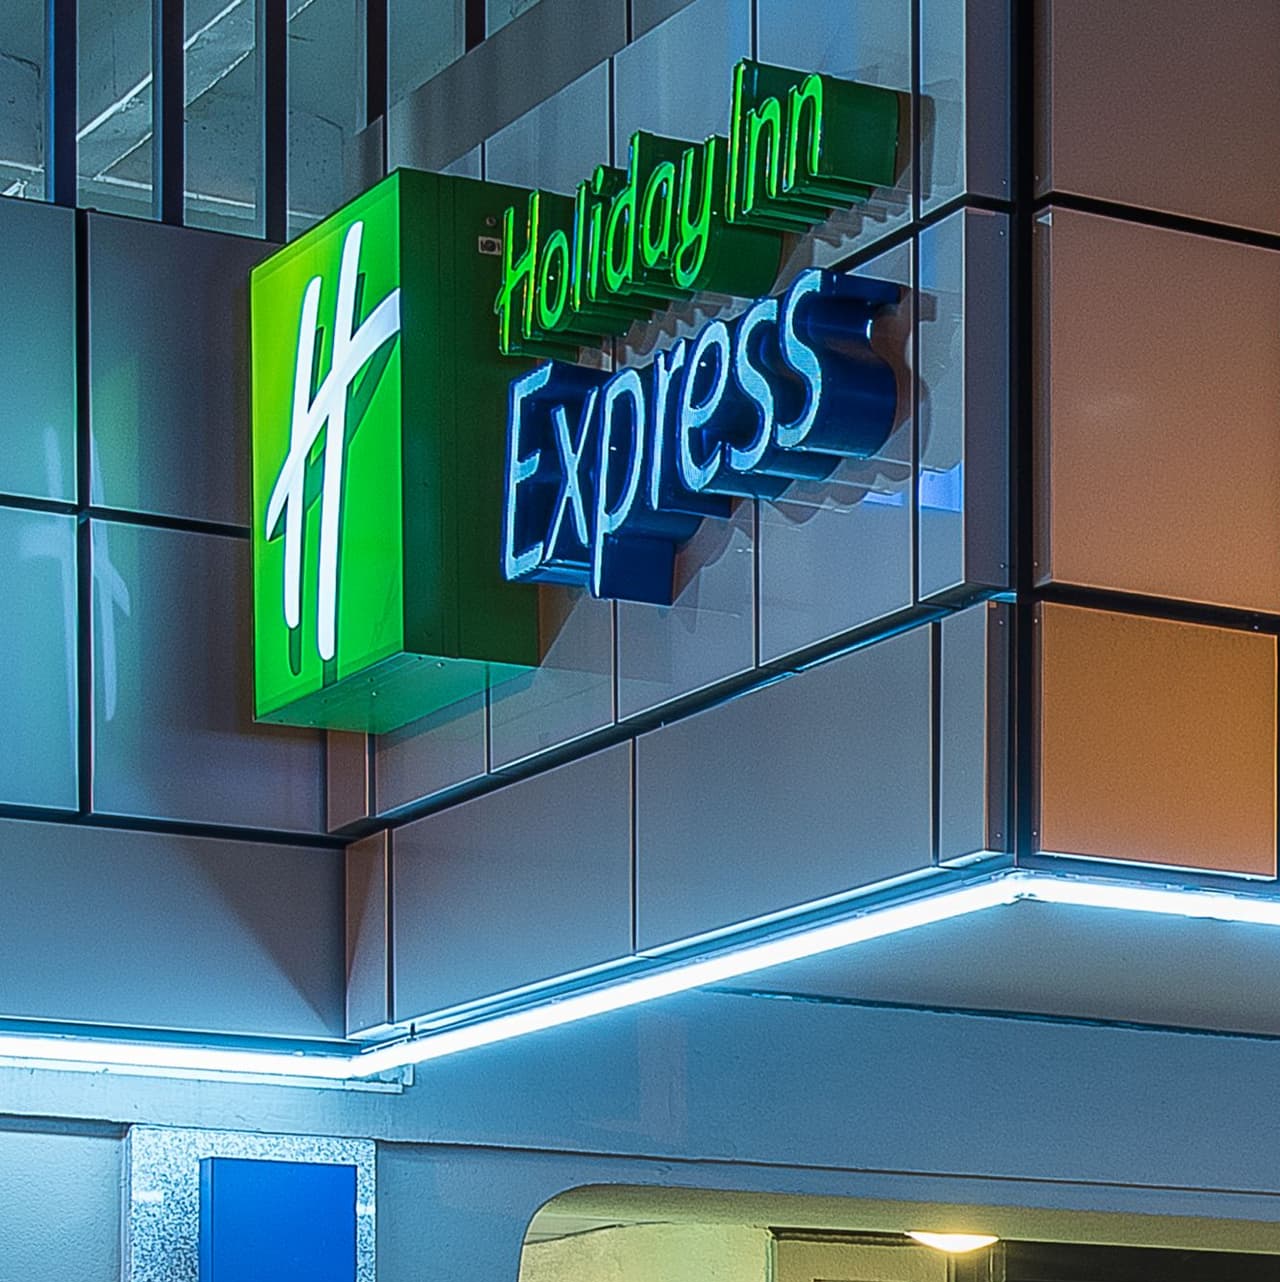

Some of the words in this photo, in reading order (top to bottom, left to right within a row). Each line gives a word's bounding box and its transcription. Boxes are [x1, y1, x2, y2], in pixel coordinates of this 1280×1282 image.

[494, 130, 716, 357] Holiday
[726, 58, 823, 223] Inn
[265, 219, 401, 662] H
[505, 267, 823, 598] Express
